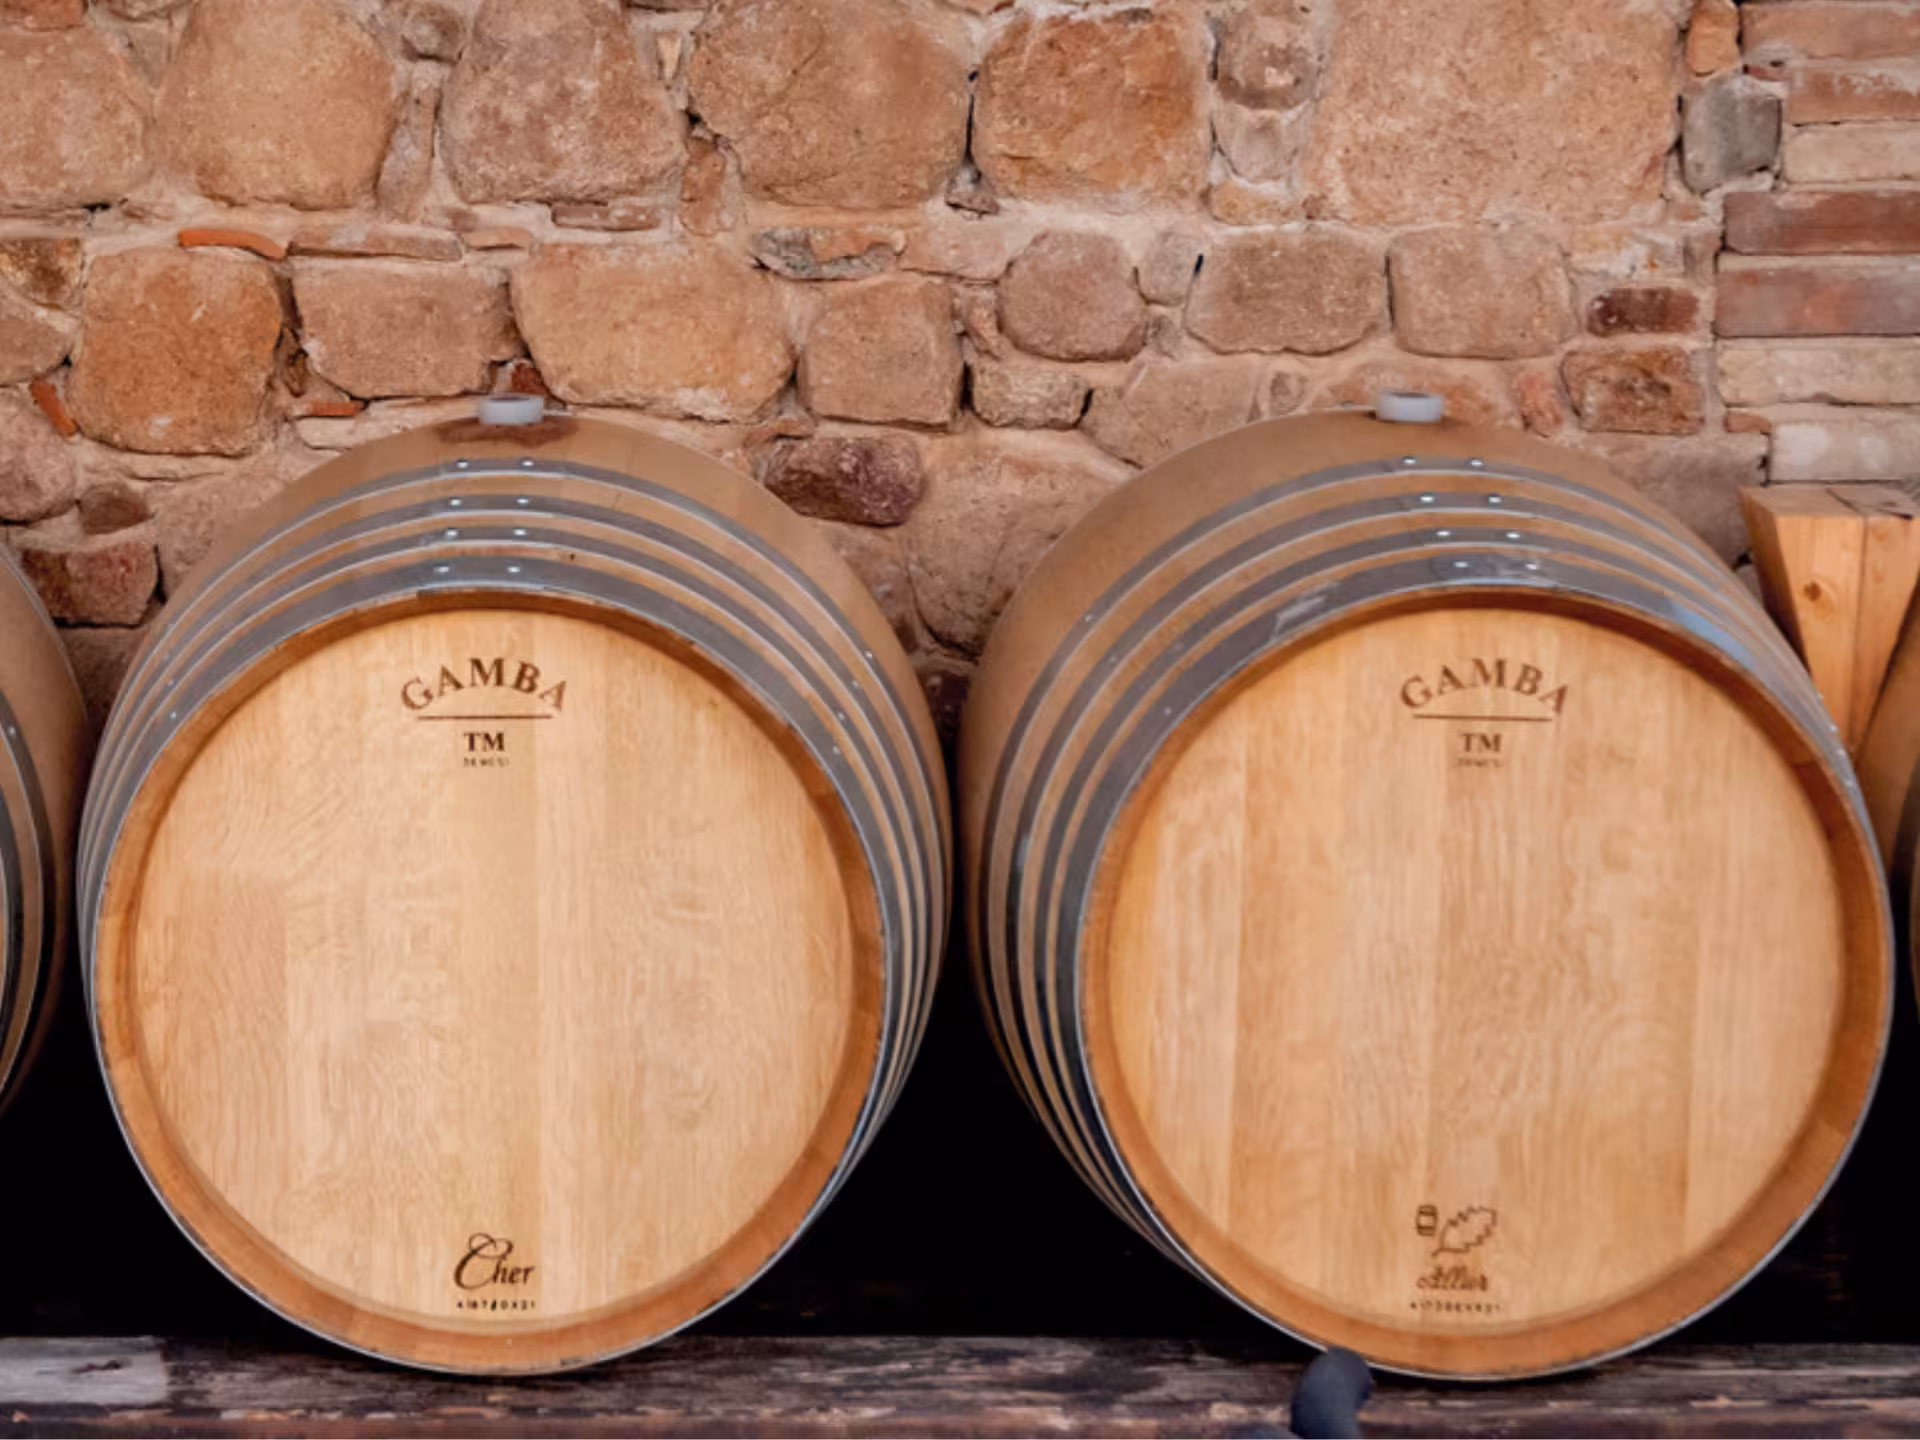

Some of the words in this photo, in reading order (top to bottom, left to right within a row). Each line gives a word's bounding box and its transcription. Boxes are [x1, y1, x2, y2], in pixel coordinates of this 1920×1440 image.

[401, 657, 566, 711] GAMBA
[1401, 657, 1568, 715] GAMBA
[463, 732, 505, 752] TM
[1460, 733, 1502, 752] TM
[454, 1232, 535, 1291] Cher
